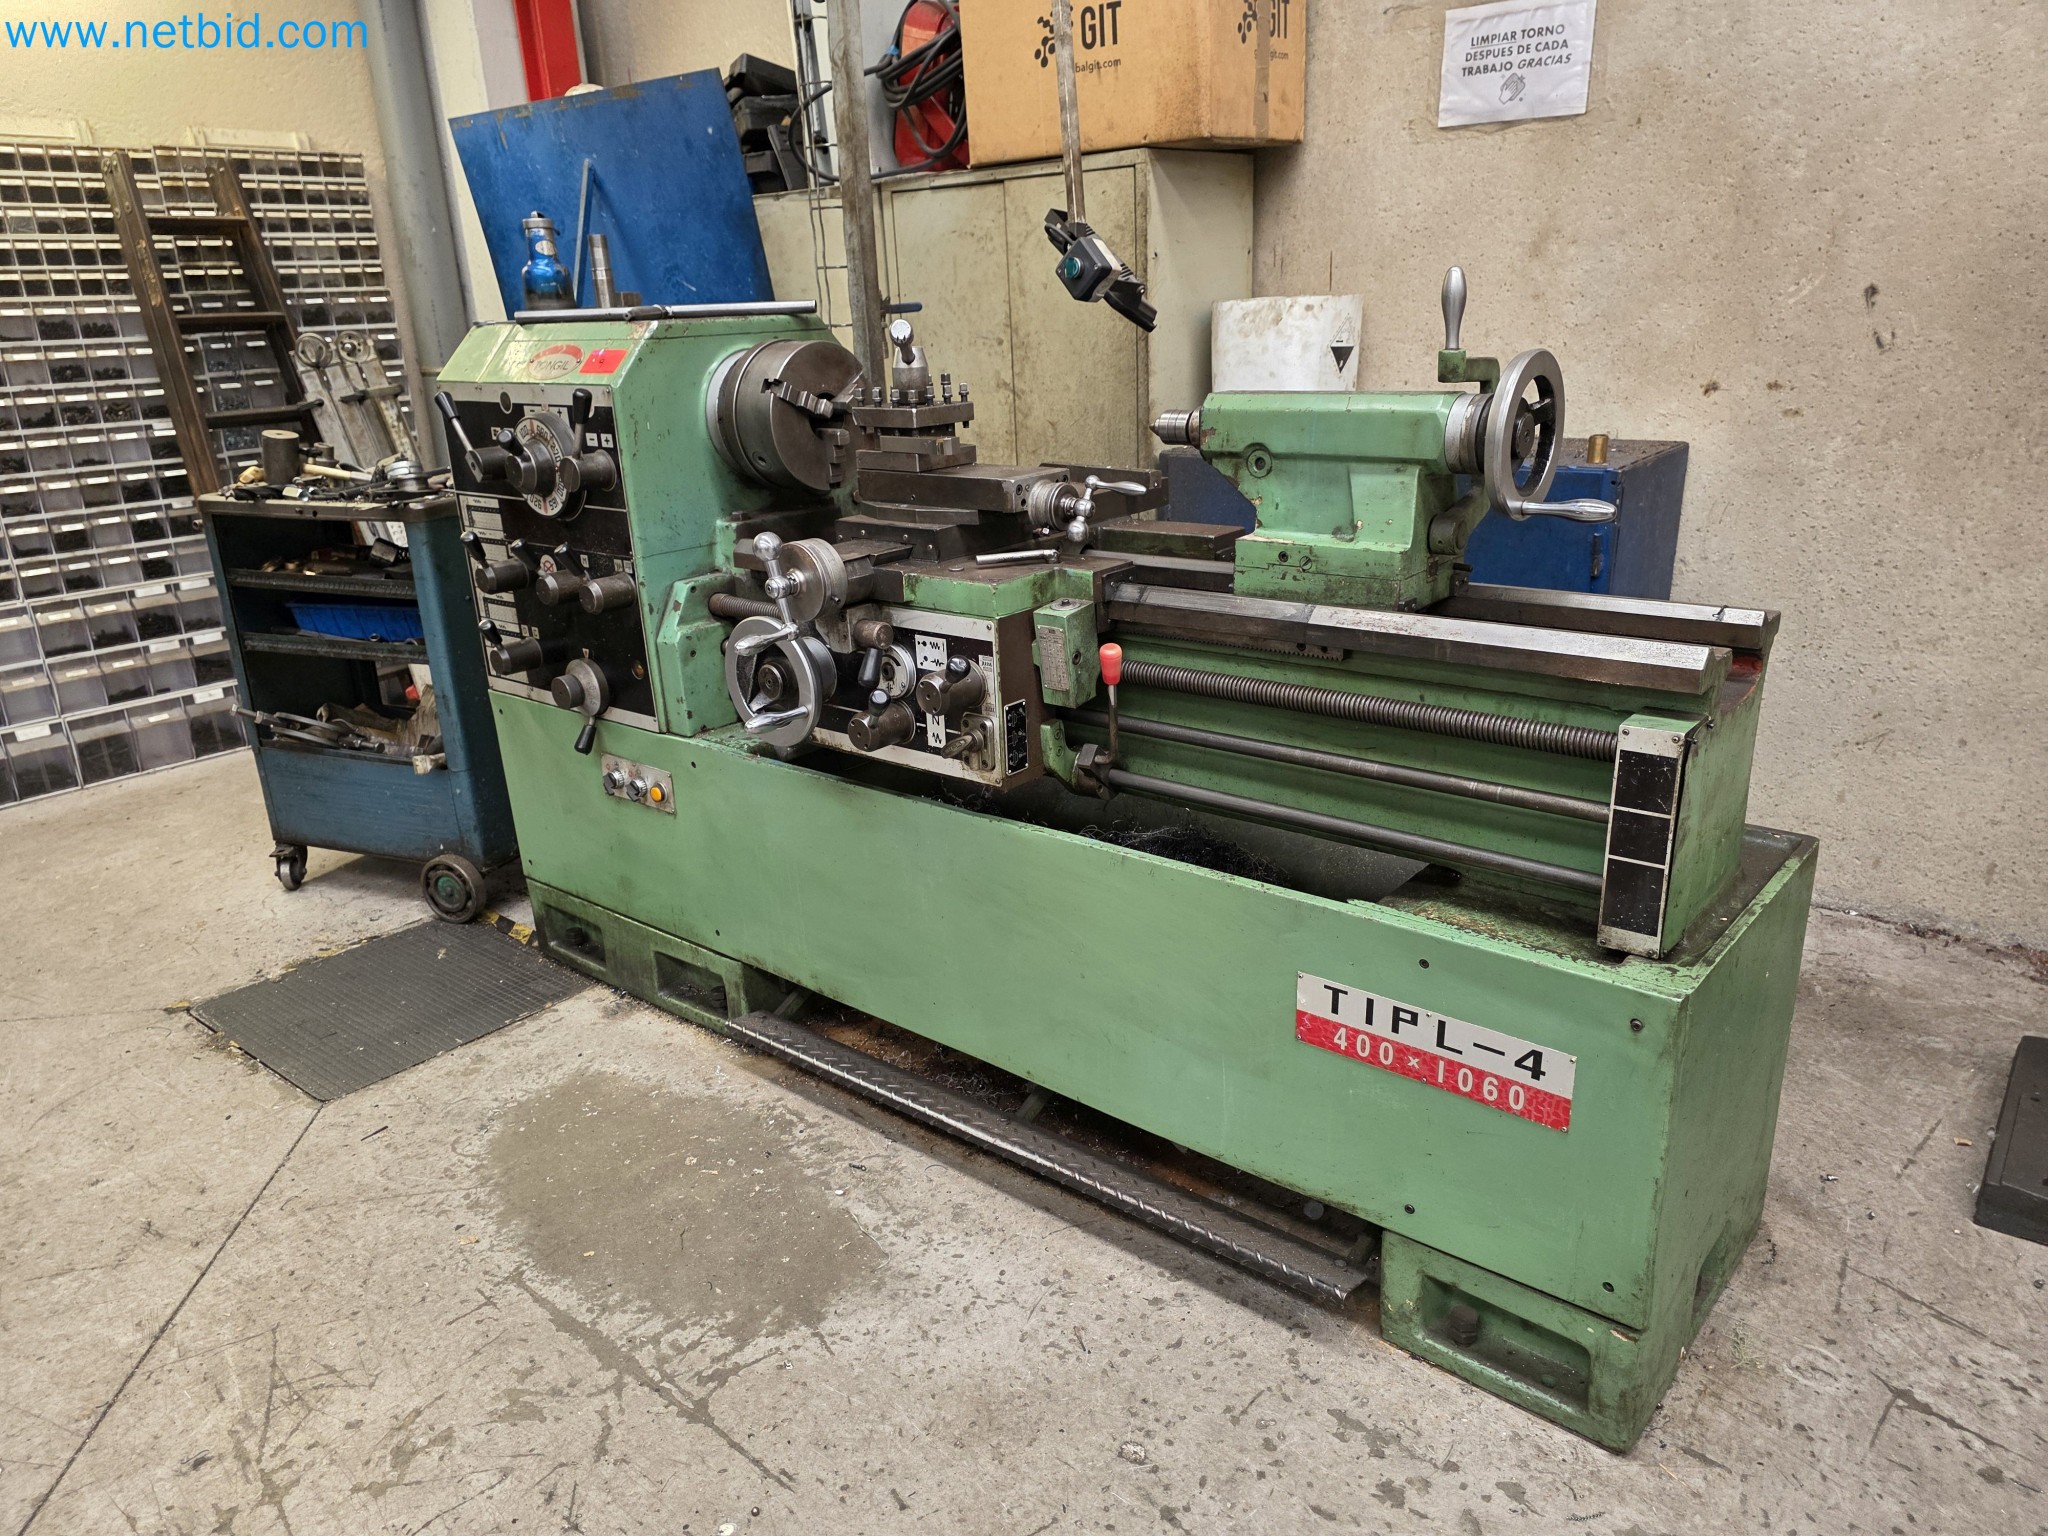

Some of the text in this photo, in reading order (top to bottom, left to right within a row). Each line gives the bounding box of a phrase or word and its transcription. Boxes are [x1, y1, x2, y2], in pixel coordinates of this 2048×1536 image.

[1080, 0, 1122, 50] GIT
[1470, 24, 1565, 47] LIMPIAR TORNO
[1465, 39, 1569, 62] DESPUES DE CADA
[1074, 58, 1122, 74] balgit.com
[1461, 53, 1573, 77] TRABAJO GRACIAS
[1323, 984, 1546, 1082] TIPL-4
